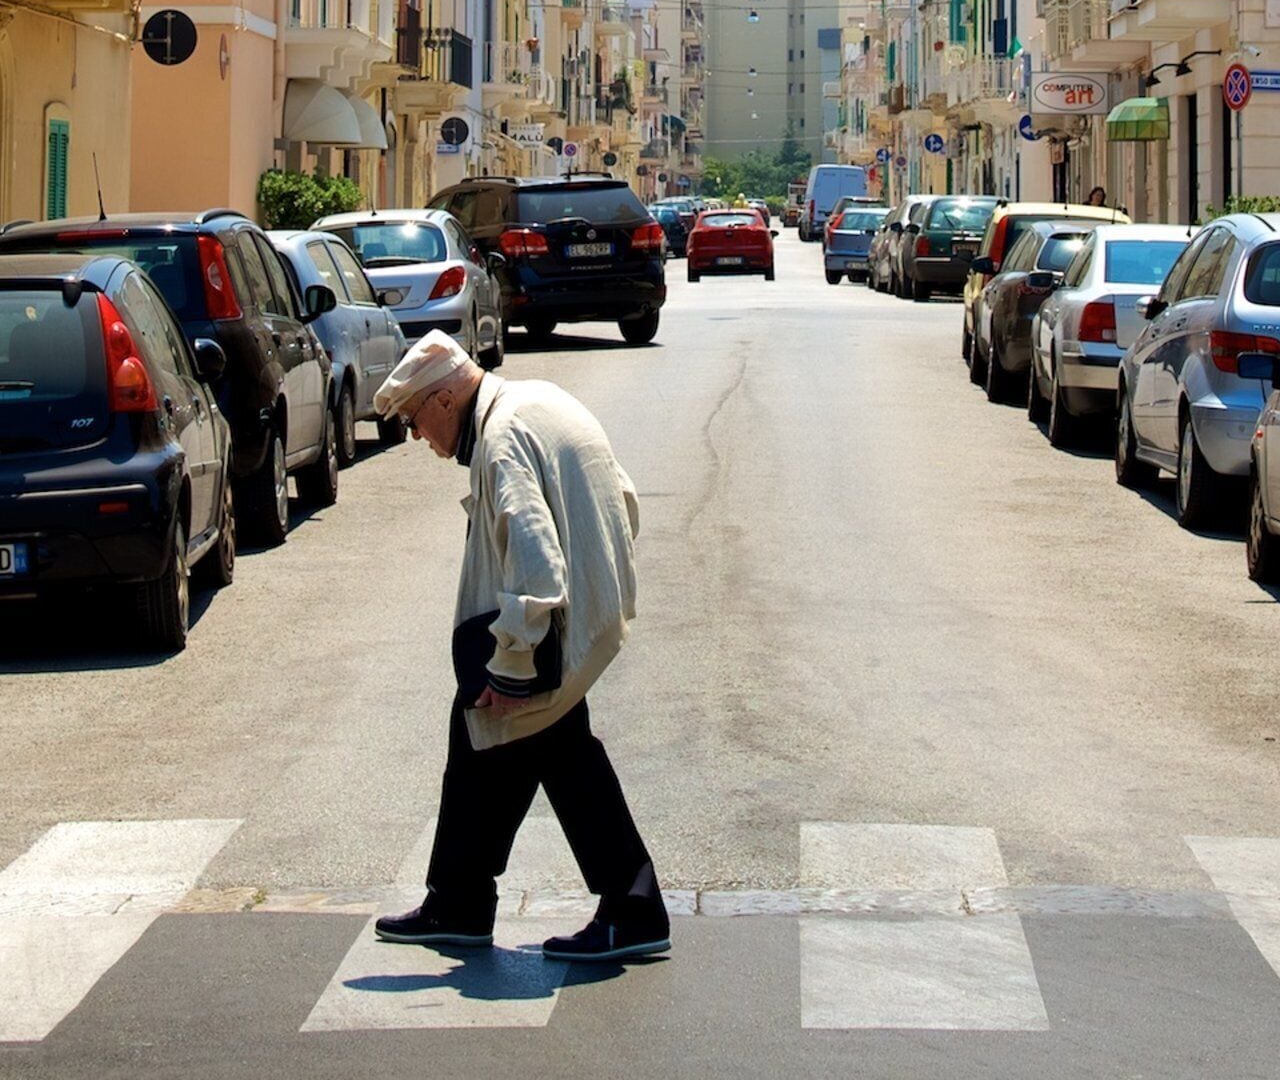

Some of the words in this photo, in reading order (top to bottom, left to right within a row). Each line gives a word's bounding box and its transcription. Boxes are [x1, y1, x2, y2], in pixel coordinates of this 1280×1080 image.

[1043, 83, 1093, 92] COMPUTER
[1065, 88, 1093, 104] art
[70, 418, 94, 428] 107
